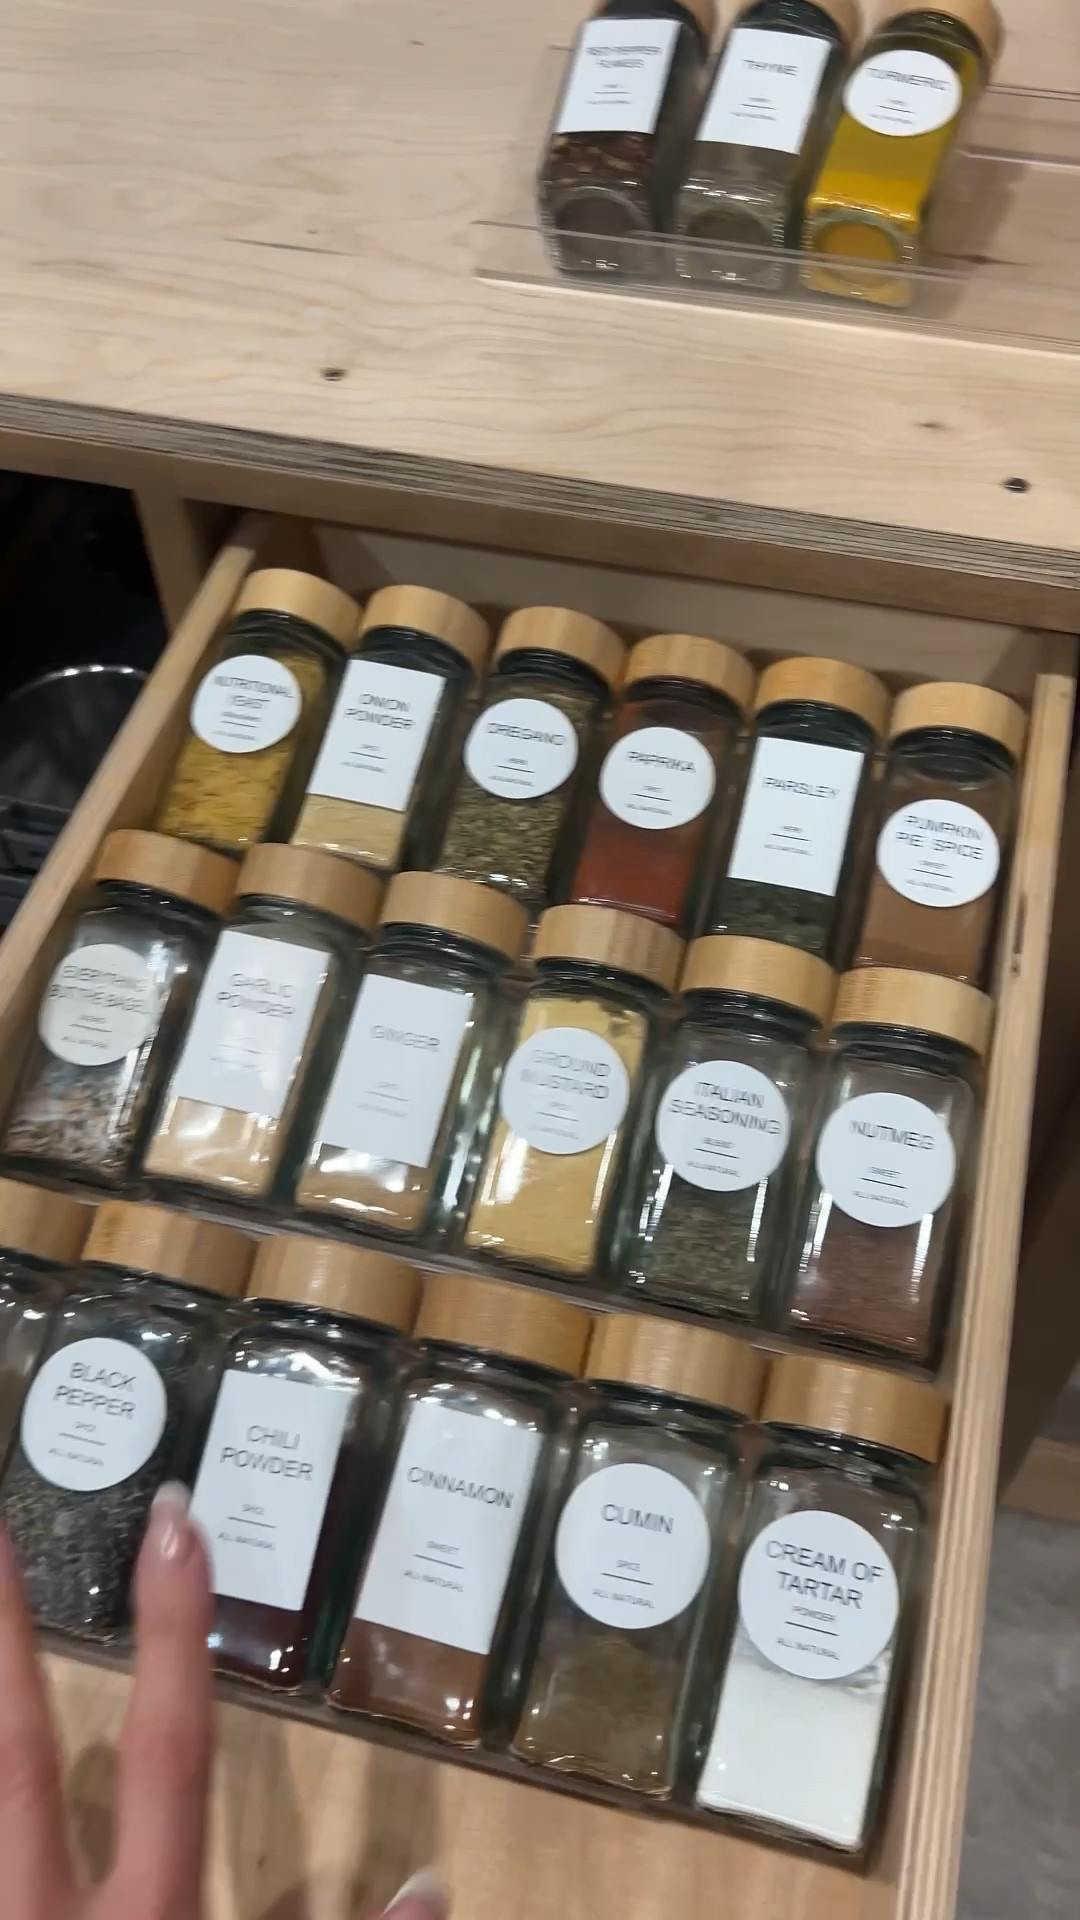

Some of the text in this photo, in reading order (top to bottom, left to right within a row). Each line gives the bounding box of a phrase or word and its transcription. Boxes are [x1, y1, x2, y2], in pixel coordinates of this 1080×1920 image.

[762, 776, 841, 800] PARSLEY
[903, 814, 984, 841] PUMPKIN
[932, 838, 985, 861] SPICE
[694, 1080, 765, 1109] ITALIAN
[667, 1098, 782, 1136] SEASONING
[850, 1118, 936, 1151] NUTMEG
[68, 1361, 136, 1393] BLACK
[52, 1384, 137, 1420] PEPPER
[245, 1423, 301, 1450] CHILI
[219, 1446, 314, 1481] POWDER
[406, 1465, 514, 1509] CINNAMON
[601, 1502, 674, 1534] CUMIN
[765, 1539, 885, 1583] CREAM OF
[776, 1570, 864, 1610] TARTAR
